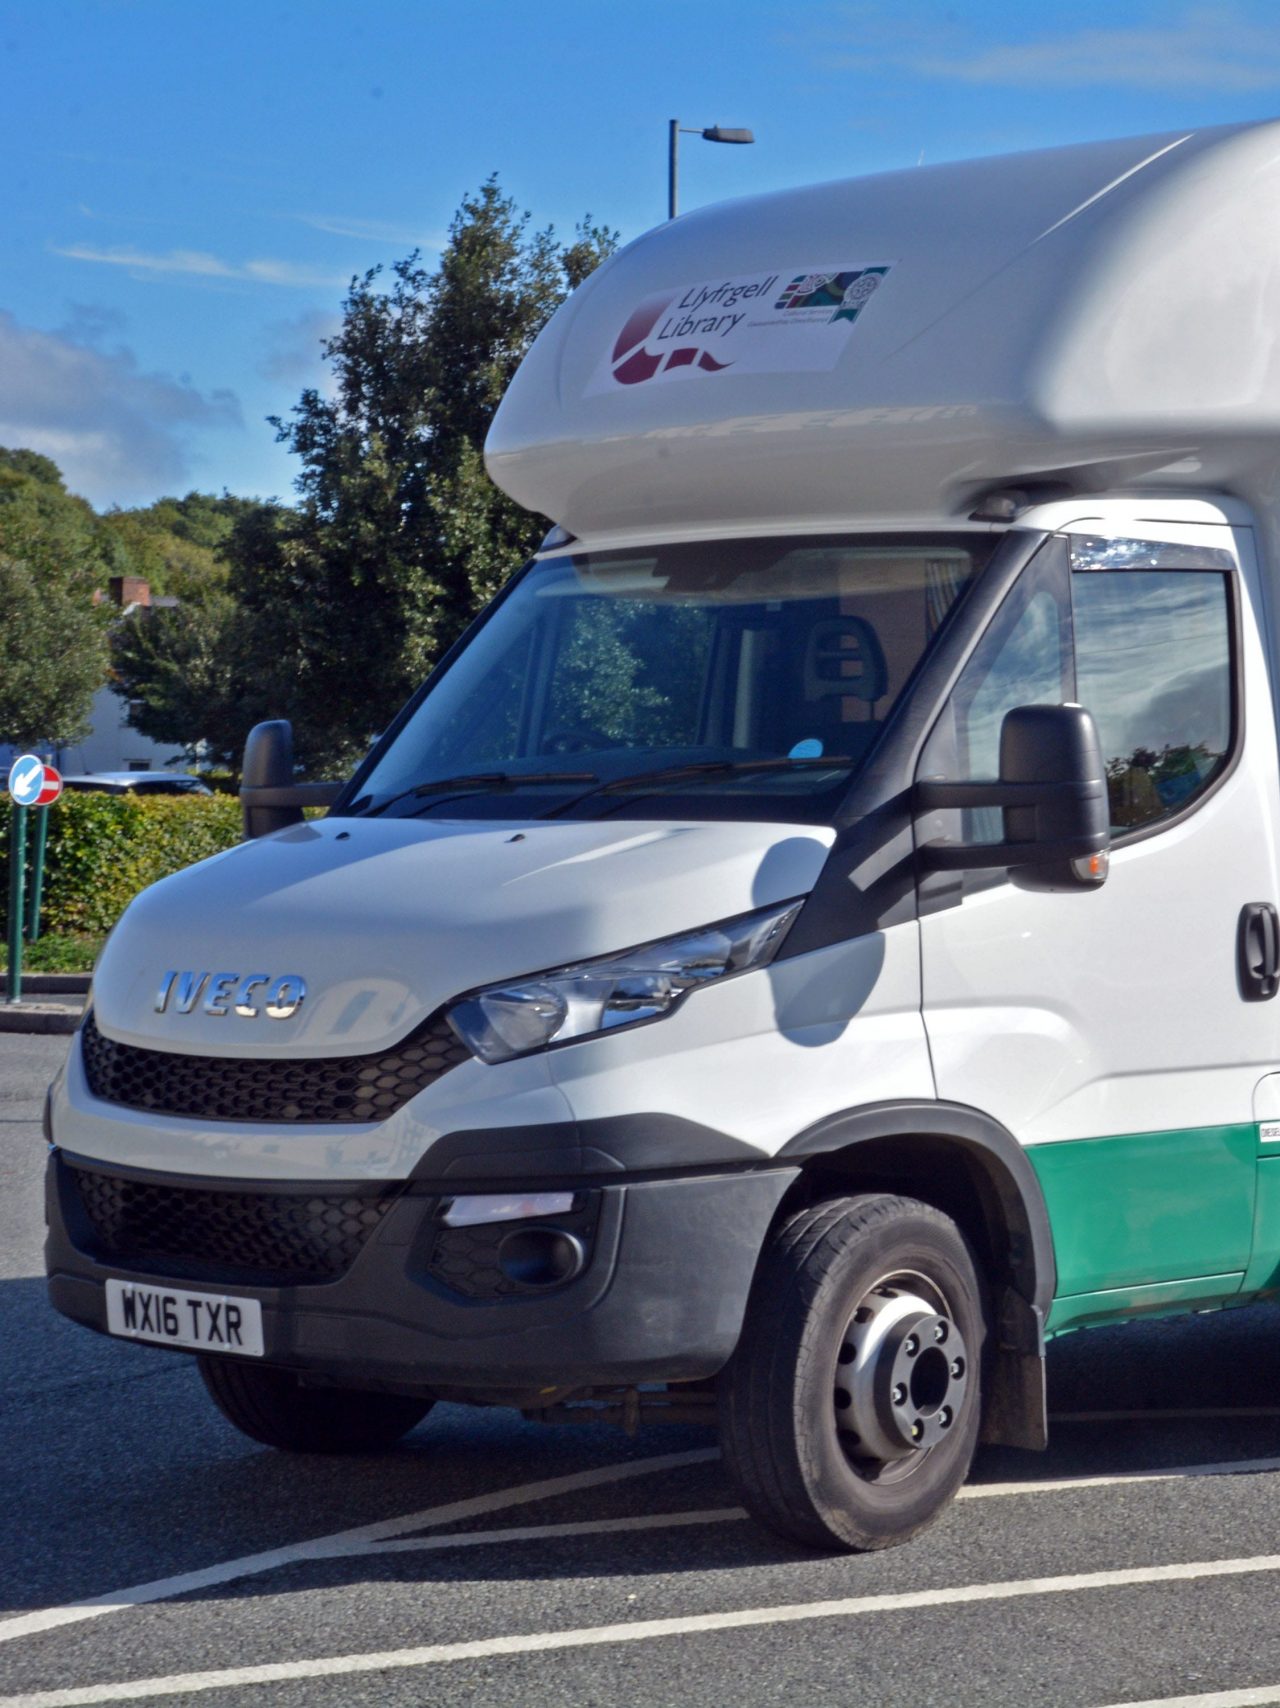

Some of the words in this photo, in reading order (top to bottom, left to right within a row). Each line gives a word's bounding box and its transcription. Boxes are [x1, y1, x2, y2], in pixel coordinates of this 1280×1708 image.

[677, 274, 780, 313] Llyfrgell
[656, 312, 747, 338] Library
[154, 969, 308, 1019] IVECO
[121, 1288, 179, 1337] WX16
[186, 1299, 243, 1347] TXR
